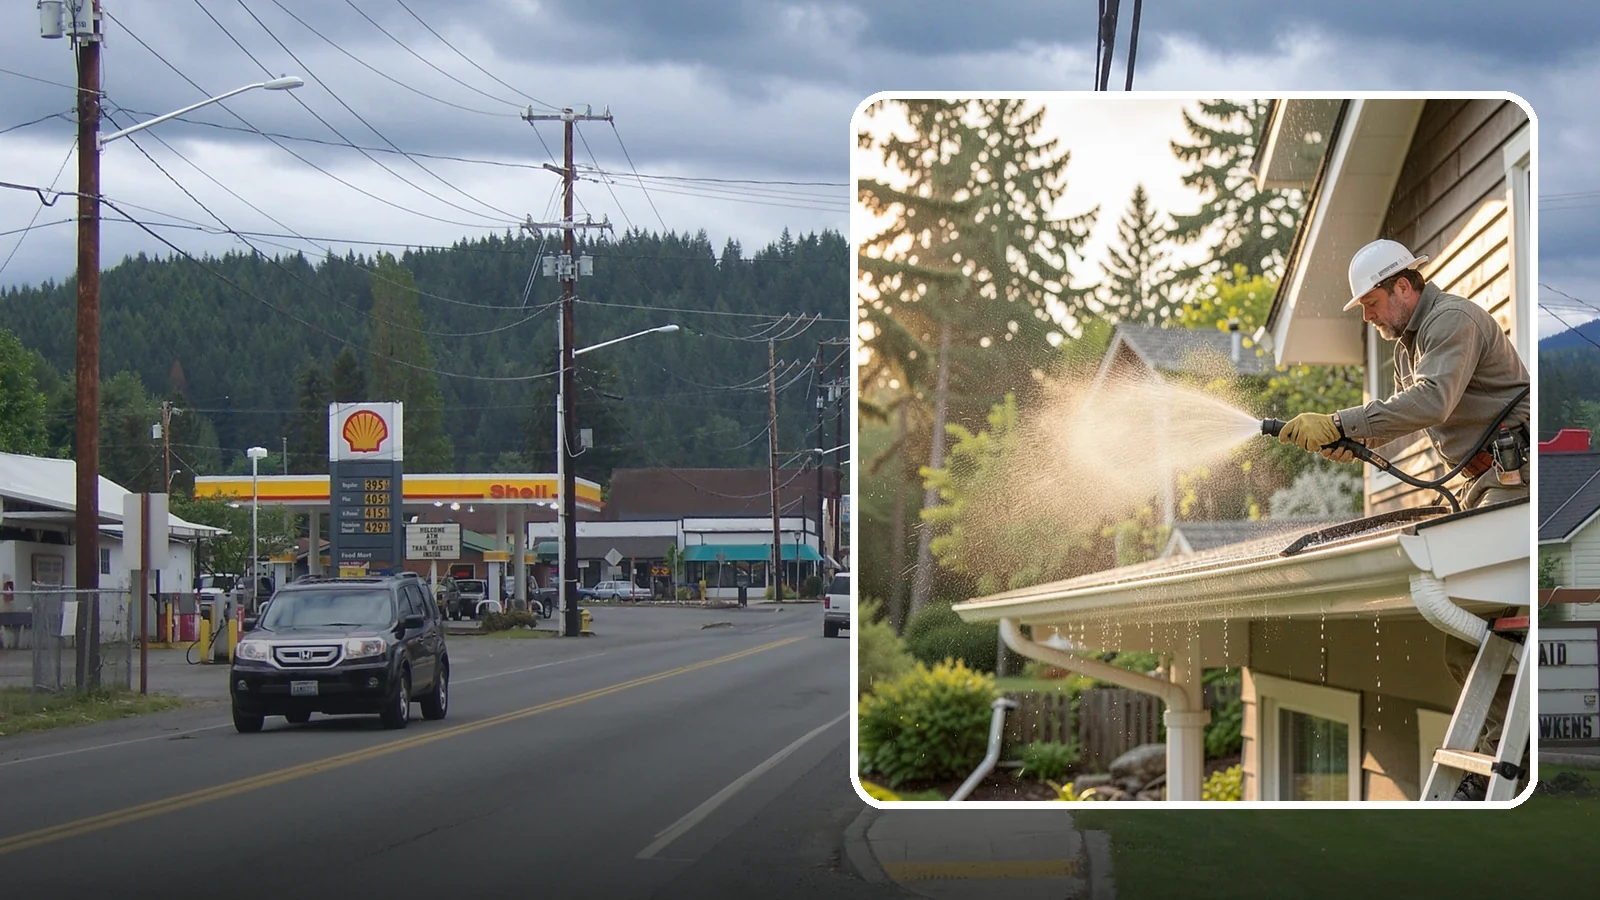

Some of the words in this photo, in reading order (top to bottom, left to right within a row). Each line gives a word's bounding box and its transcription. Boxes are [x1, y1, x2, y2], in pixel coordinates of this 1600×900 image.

[366, 480, 384, 490] 395
[490, 484, 547, 499] Shell
[366, 494, 384, 504] 405
[366, 508, 384, 518] 415
[366, 522, 384, 533] 429
